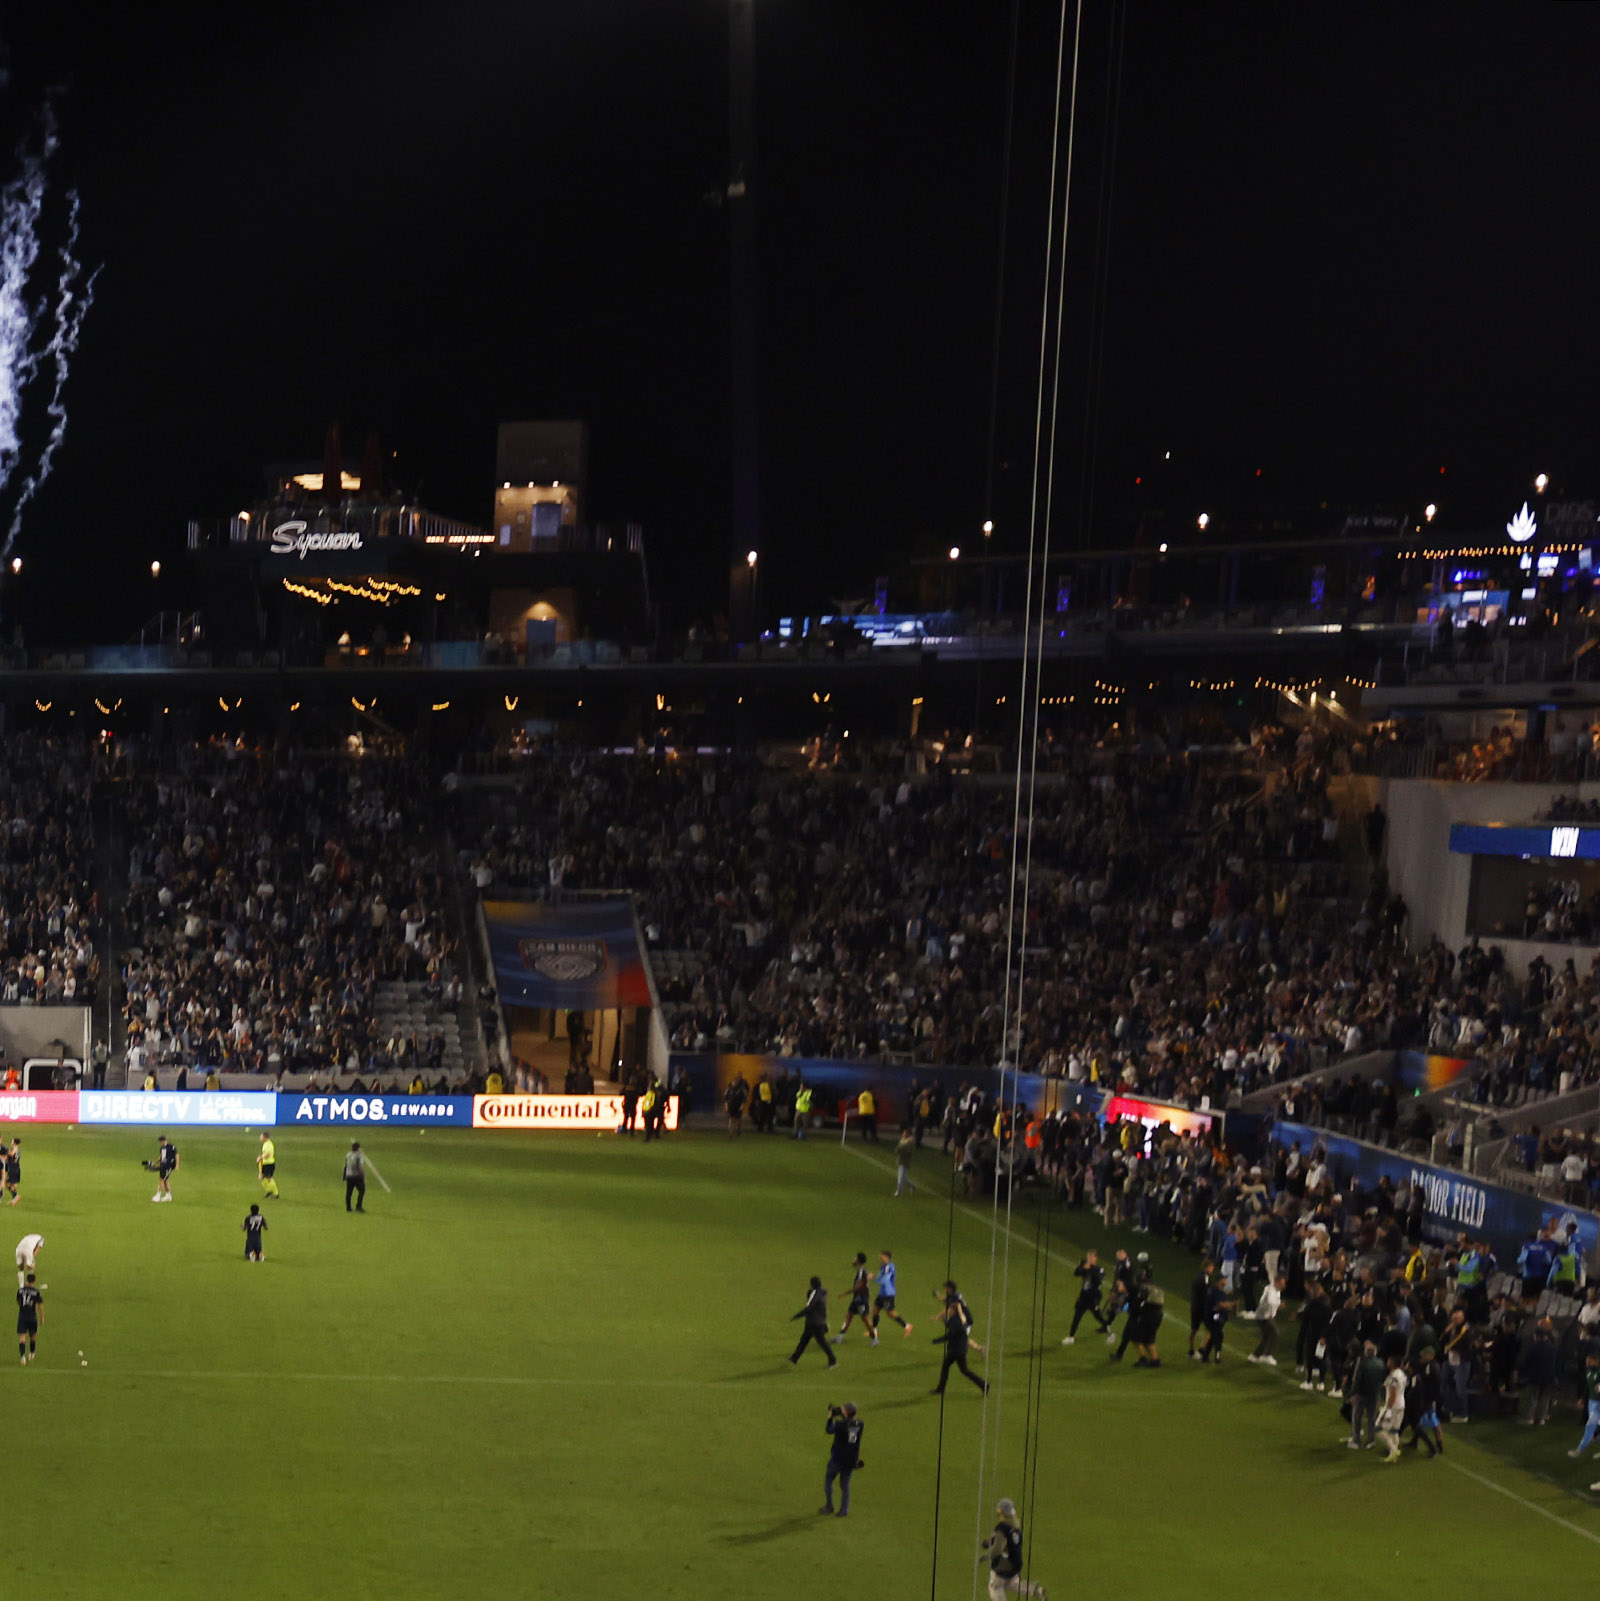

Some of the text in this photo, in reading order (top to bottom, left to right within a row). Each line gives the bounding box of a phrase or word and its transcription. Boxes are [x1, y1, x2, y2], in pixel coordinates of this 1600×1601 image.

[270, 520, 363, 560] Sycuan
[1549, 826, 1580, 857] WIN
[87, 1095, 191, 1120] DIRECTV
[392, 1104, 455, 1117] REWARDS
[479, 1098, 601, 1122] Continental
[1451, 1182, 1487, 1229] FIELD
